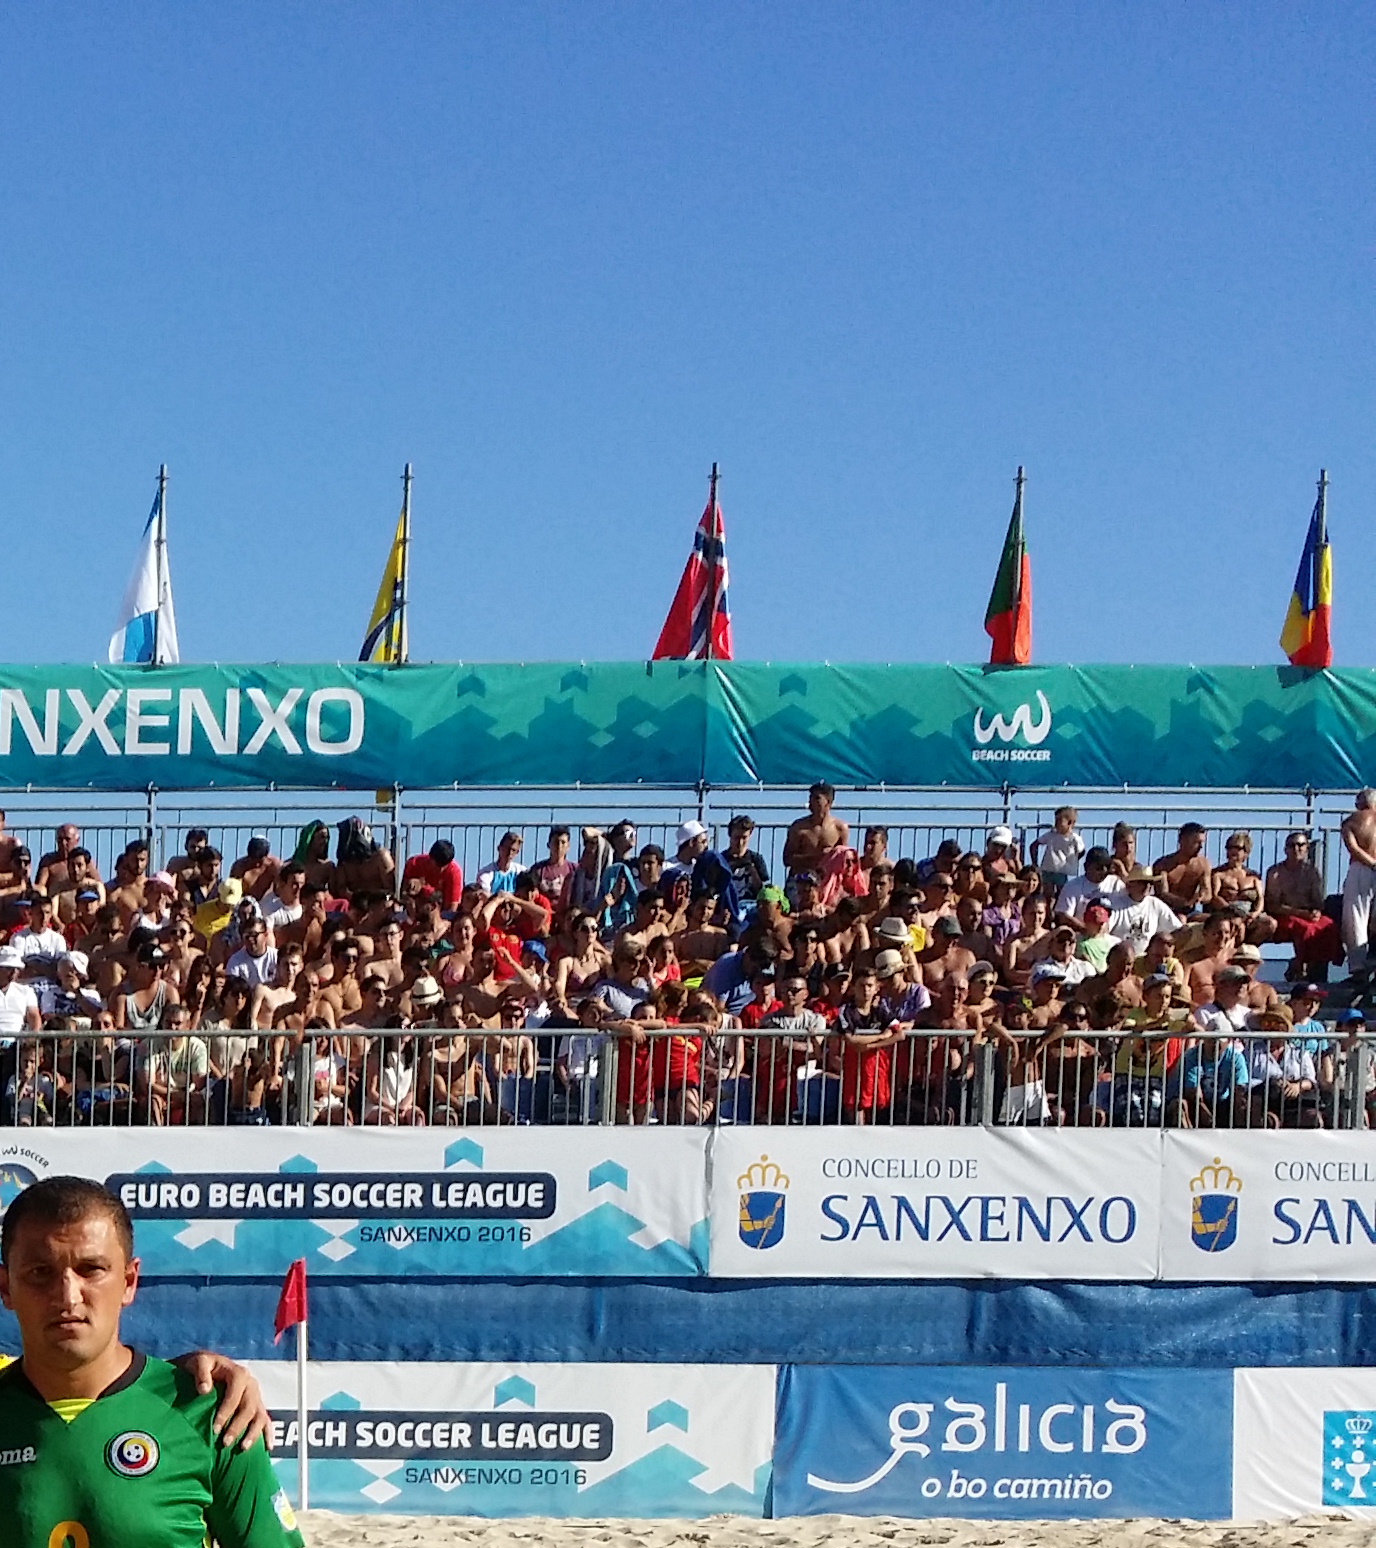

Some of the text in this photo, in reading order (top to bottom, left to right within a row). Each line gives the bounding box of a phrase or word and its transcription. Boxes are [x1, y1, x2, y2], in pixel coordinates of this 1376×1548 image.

[972, 750, 1051, 761] BEACH SOCCER
[20, 1148, 49, 1168] SOCCER
[821, 1158, 978, 1179] CONCELLO DE
[119, 1182, 545, 1209] EURO BEACH SOCCER LEAGUE
[820, 1194, 1137, 1243] SANXENXO
[359, 1226, 532, 1243] SANXENXO 2016
[356, 1421, 472, 1448] SOCCER
[481, 1422, 601, 1449] LEAGUE
[807, 1382, 1147, 1492] galicia
[405, 1467, 587, 1486] SANXENXO 2016
[920, 1470, 1113, 1500] o bo camiño
